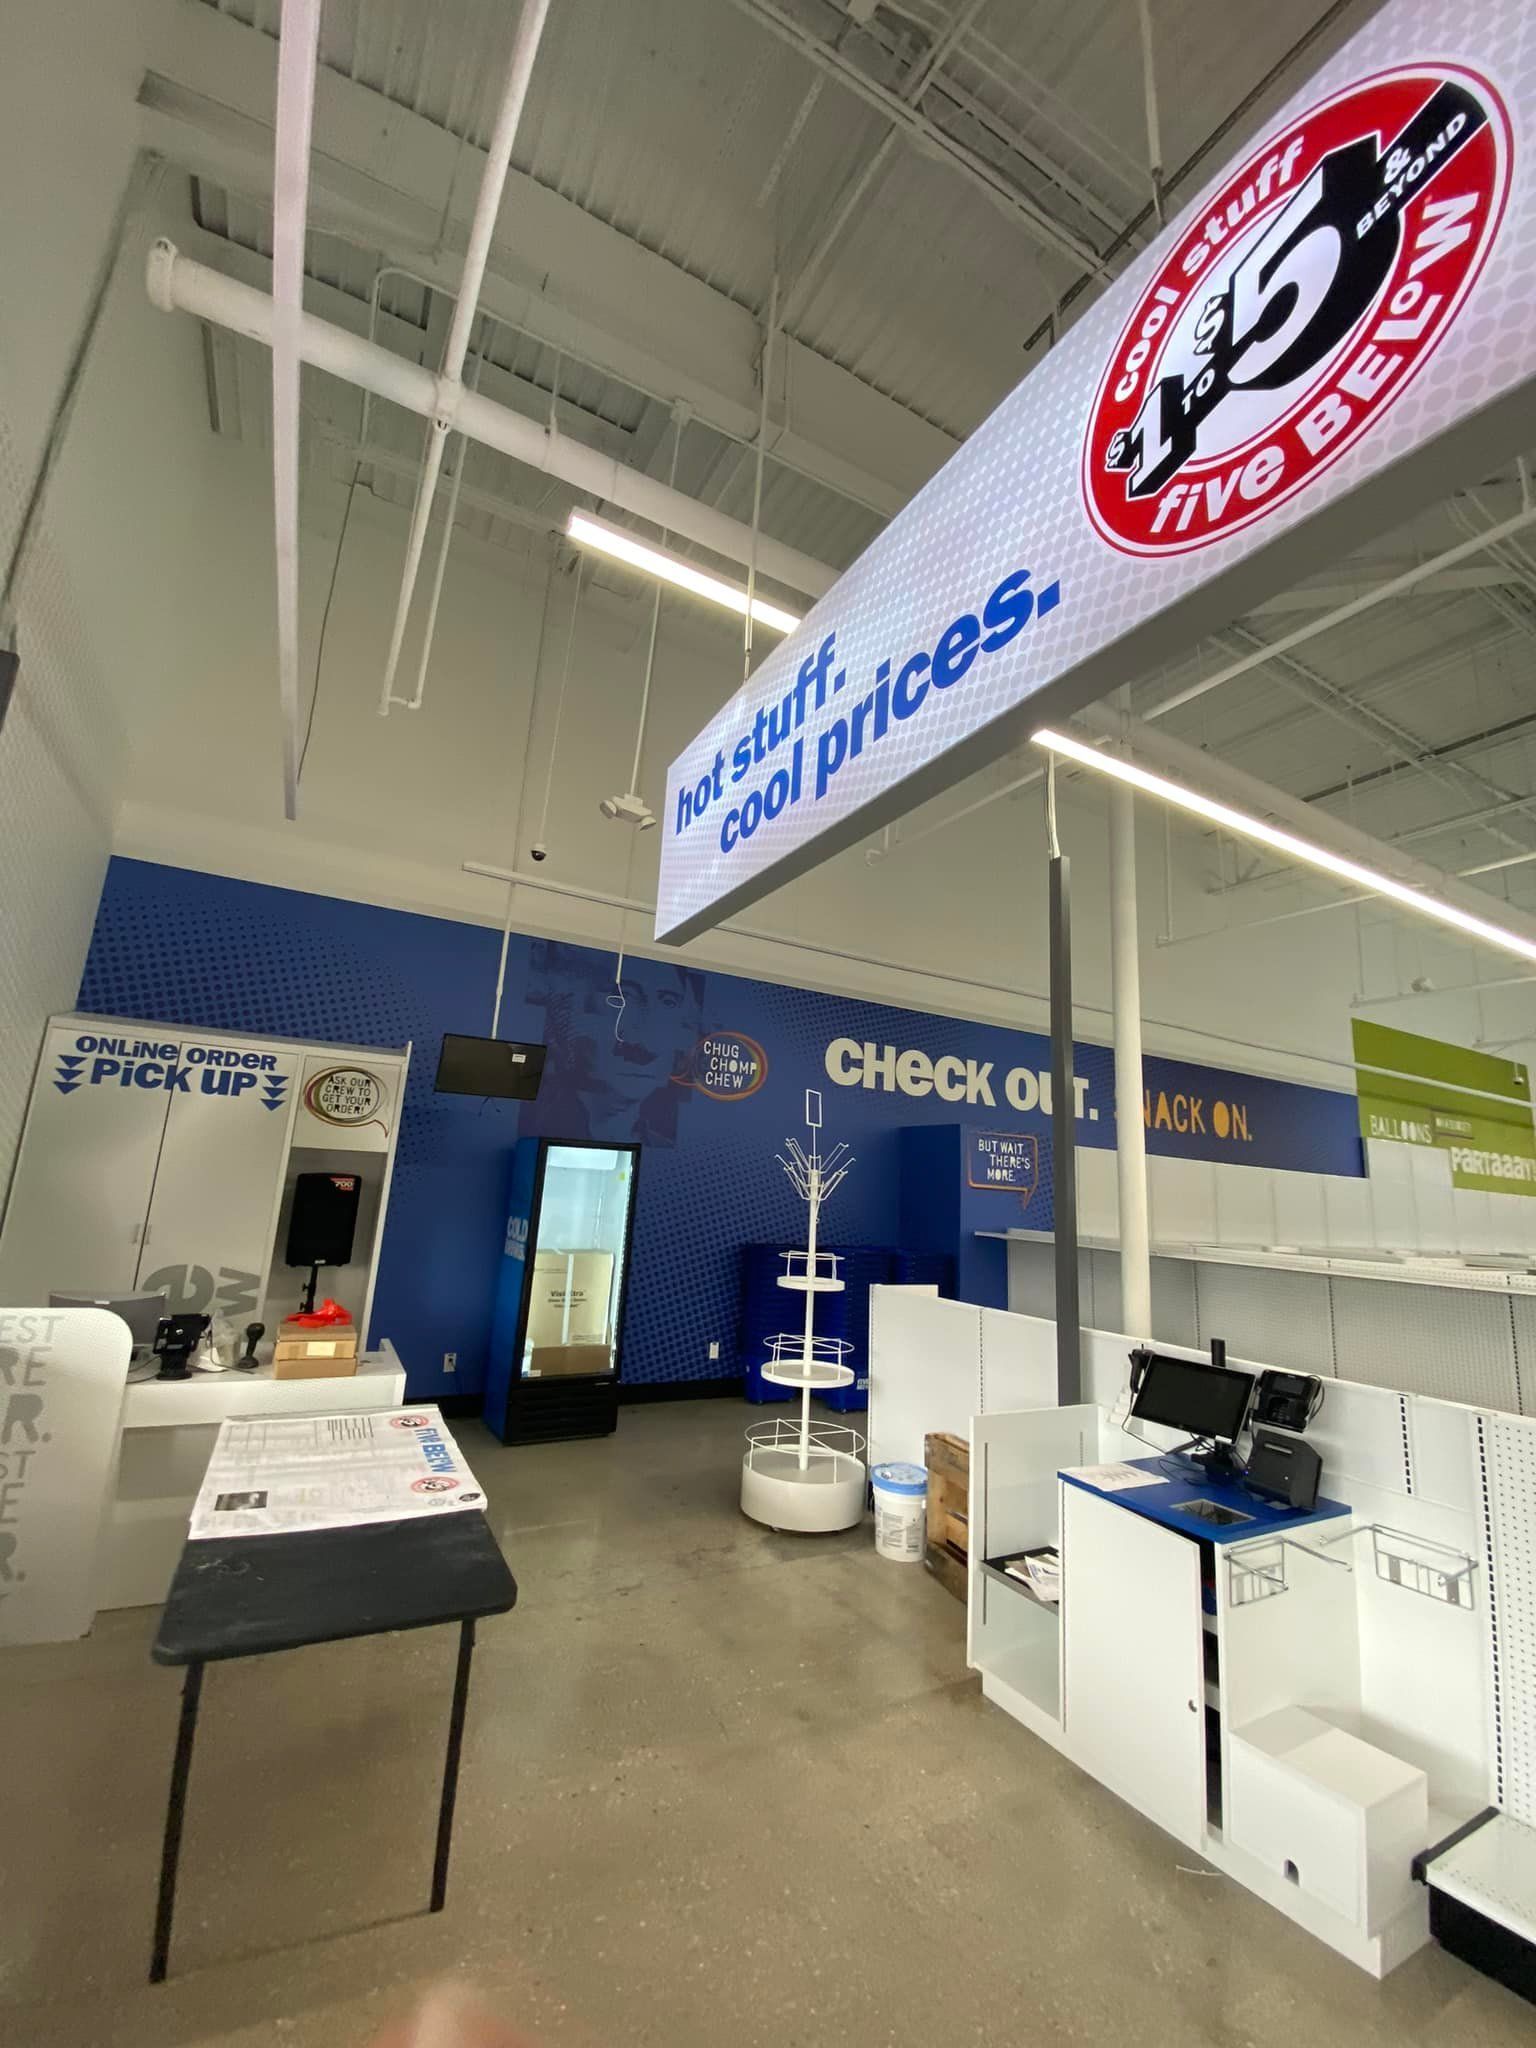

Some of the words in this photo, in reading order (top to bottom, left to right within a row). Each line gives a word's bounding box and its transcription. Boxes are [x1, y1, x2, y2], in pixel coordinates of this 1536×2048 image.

[1356, 111, 1467, 239] BEYOND
[1384, 146, 1410, 182] &
[1115, 284, 1180, 402] cool
[1183, 137, 1305, 276] stuff
[1181, 368, 1217, 415] TO
[1150, 446, 1284, 533] five
[720, 739, 803, 854] cool
[815, 568, 1061, 801] prices.
[676, 750, 725, 836] hot
[732, 631, 847, 784] stuff.
[703, 1041, 739, 1059] CHUG
[710, 1057, 757, 1075] CHOMP
[325, 1085, 355, 1095] CREW
[359, 1088, 371, 1096] TO
[328, 1075, 347, 1085] ASK
[350, 1078, 371, 1087] OUR
[705, 1071, 743, 1089] CHEW
[322, 1094, 341, 1103] GET
[345, 1096, 371, 1106] YOUR
[326, 1104, 365, 1115] ORDER!
[1212, 1100, 1253, 1142] ON.
[1369, 1114, 1433, 1144] BALLOONS
[978, 1138, 998, 1153] BUT
[1001, 1142, 1024, 1155] WAIT
[990, 1154, 1031, 1170] THERE'S
